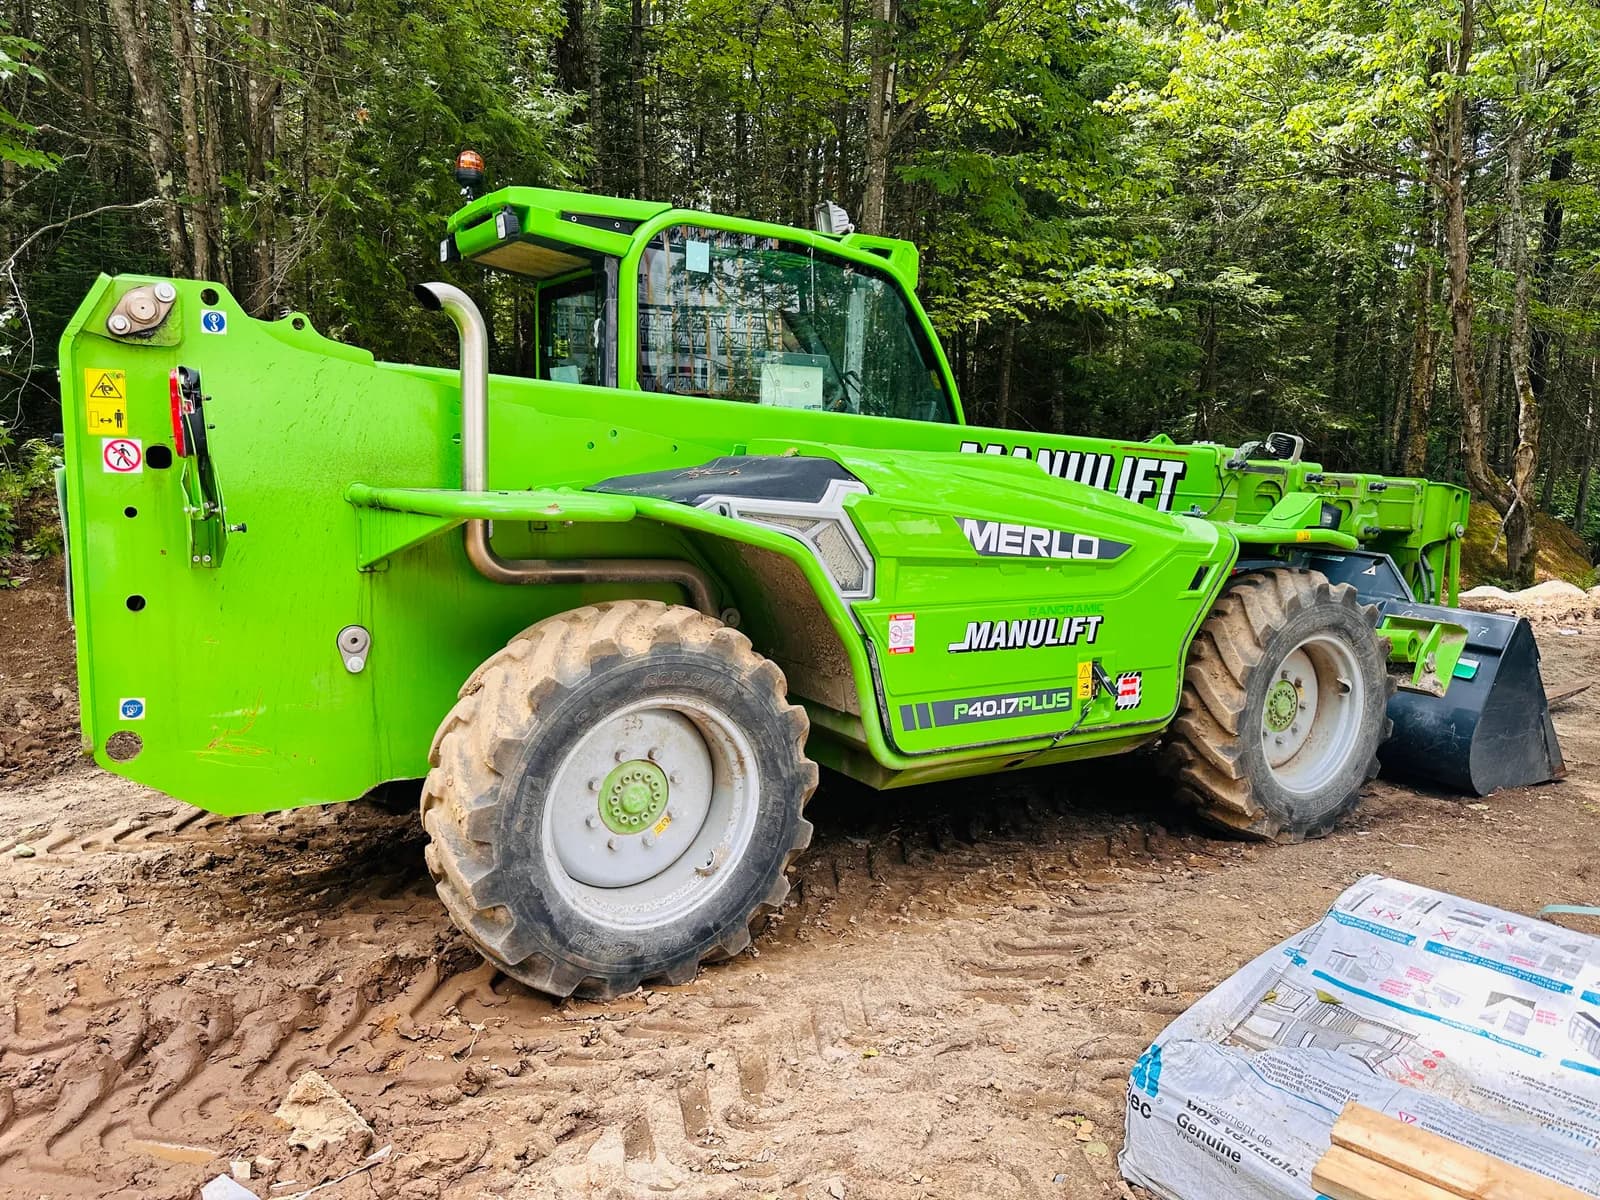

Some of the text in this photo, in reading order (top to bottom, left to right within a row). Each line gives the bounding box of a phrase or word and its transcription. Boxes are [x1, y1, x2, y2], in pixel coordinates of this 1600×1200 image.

[963, 518, 1100, 560] MERLO
[948, 615, 1104, 653] MANULIFT
[953, 691, 1070, 720] P40.17PLUS
[1173, 1111, 1244, 1163] Genuine
[1256, 1132, 1274, 1148] de
[1420, 1121, 1465, 1142] COMPLIANCE
[1465, 1139, 1484, 1150] WITH
